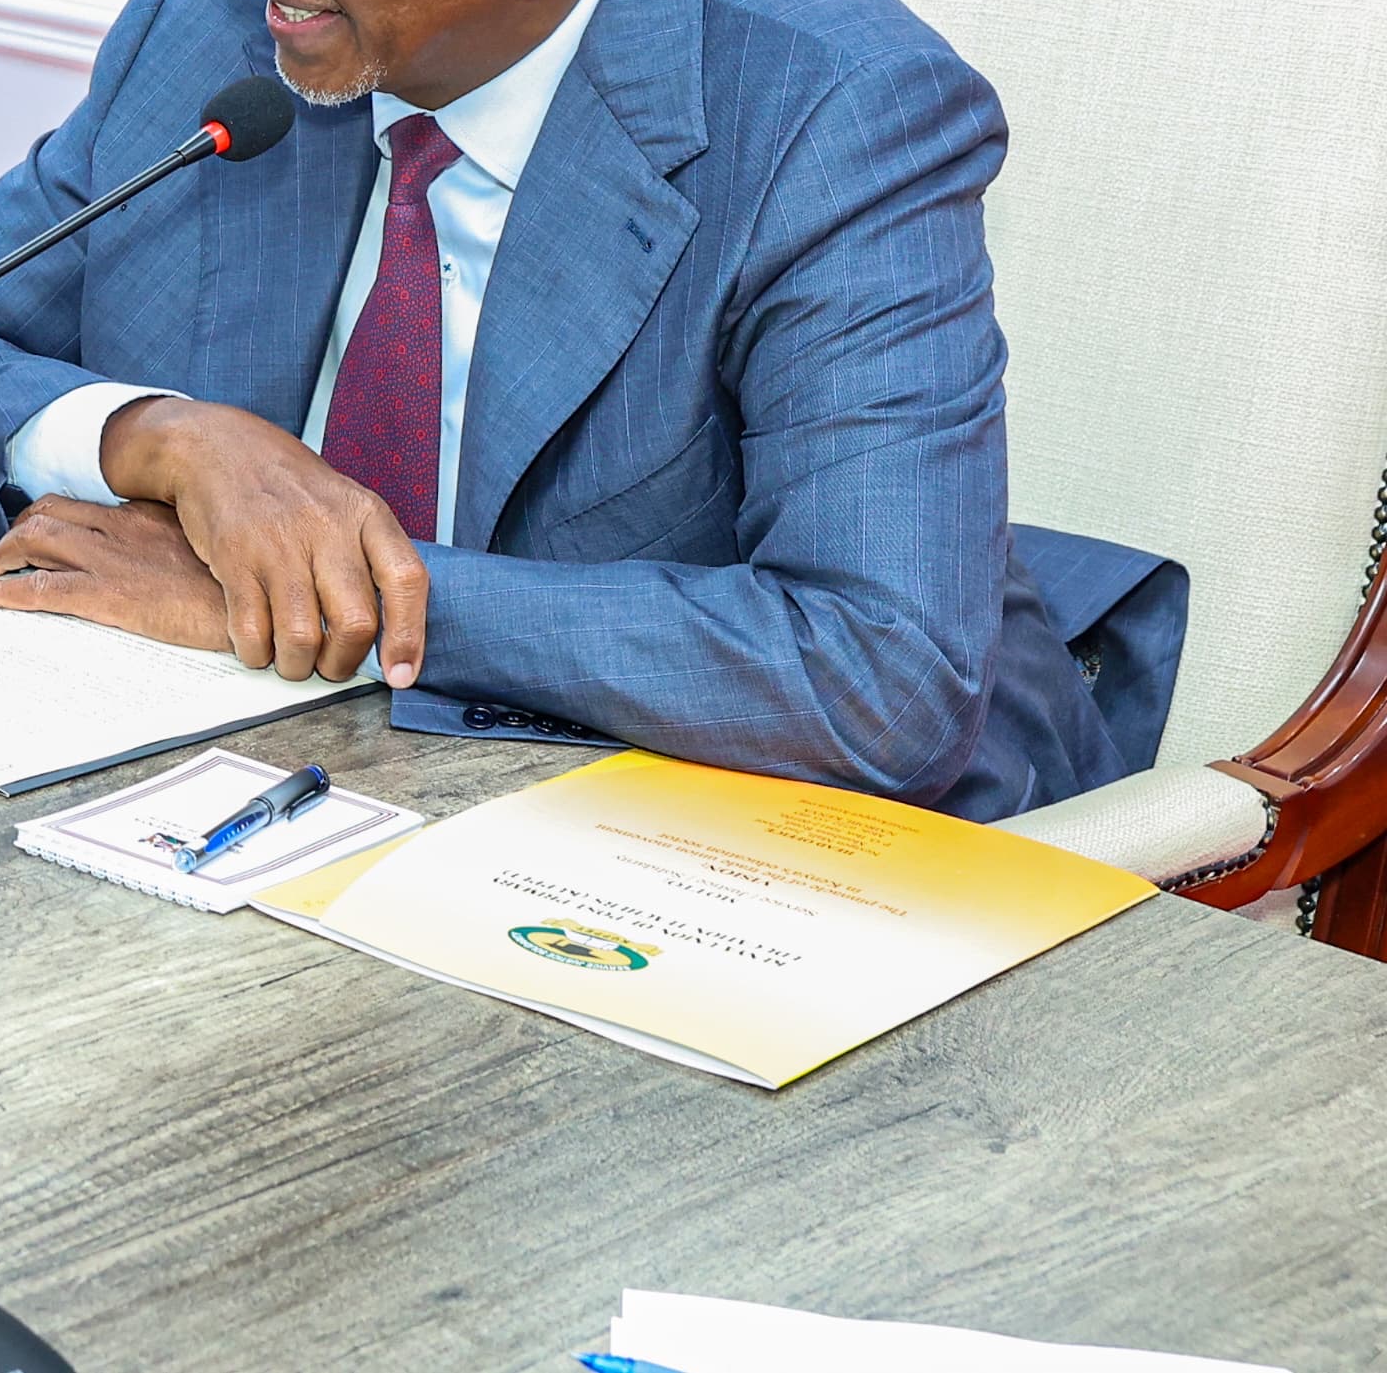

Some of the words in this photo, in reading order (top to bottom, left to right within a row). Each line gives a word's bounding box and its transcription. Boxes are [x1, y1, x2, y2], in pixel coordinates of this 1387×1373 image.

[595, 824, 672, 849] movement
[657, 833, 702, 849] sector
[707, 845, 778, 870] education
[720, 860, 759, 874] trade
[493, 877, 570, 905] PRIMARY
[809, 884, 878, 906] pinnacle
[576, 904, 624, 921] POST
[879, 904, 908, 917] The
